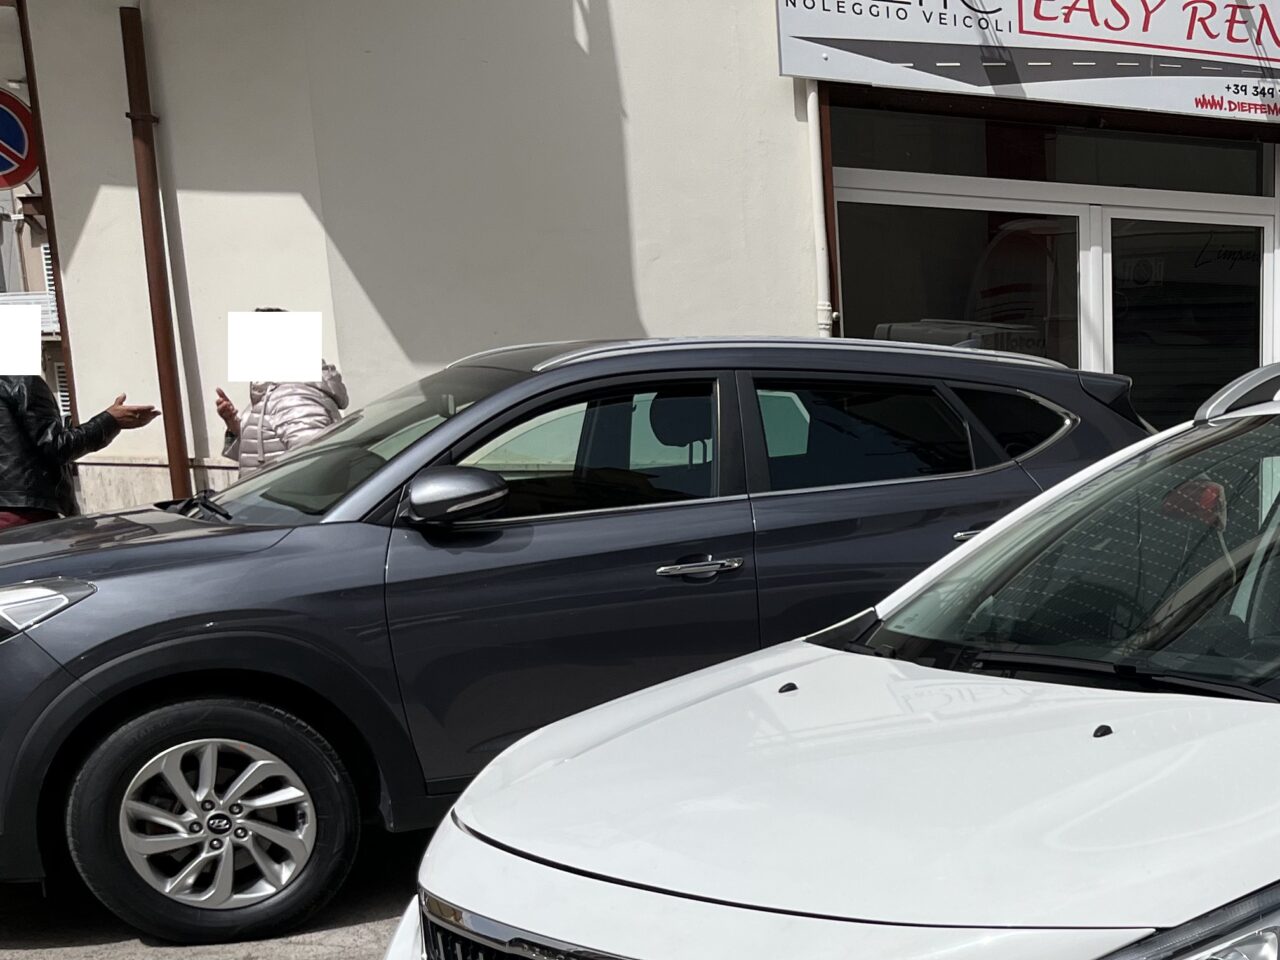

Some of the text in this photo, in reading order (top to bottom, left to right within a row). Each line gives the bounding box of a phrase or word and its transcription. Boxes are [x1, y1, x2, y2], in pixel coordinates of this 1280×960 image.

[785, 0, 908, 20] NOLEGGIO
[922, 10, 1012, 33] VEICOLI
[1225, 84, 1247, 95] +39
[1252, 86, 1274, 98] 349
